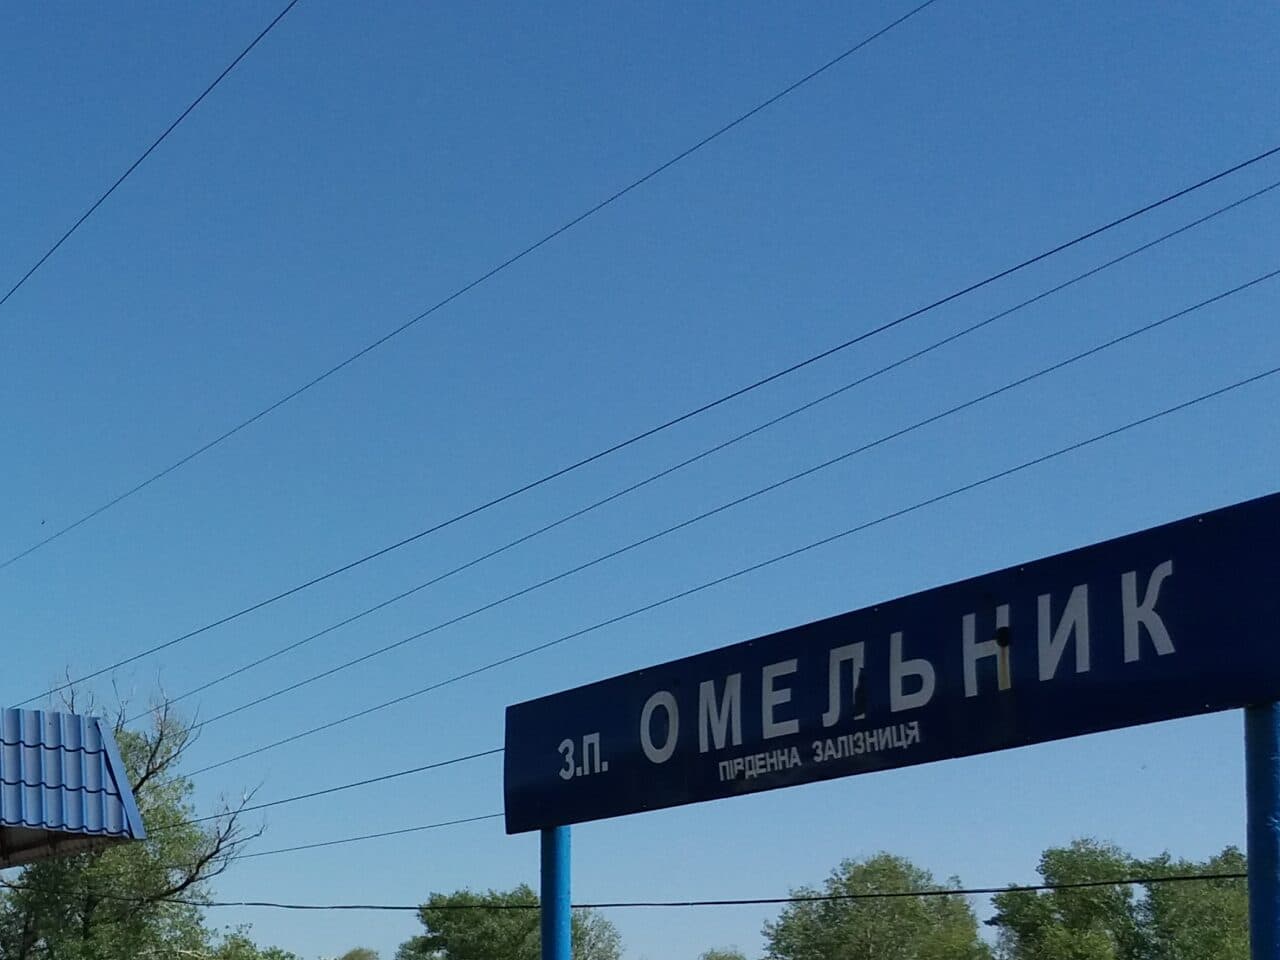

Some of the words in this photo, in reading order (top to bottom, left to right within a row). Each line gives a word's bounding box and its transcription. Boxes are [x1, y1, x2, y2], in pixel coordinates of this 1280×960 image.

[558, 732, 609, 780] З.П.
[640, 560, 1176, 764] ОМЕЛЬНИК
[811, 720, 921, 763] ЗАЛІЗНИЦЯ
